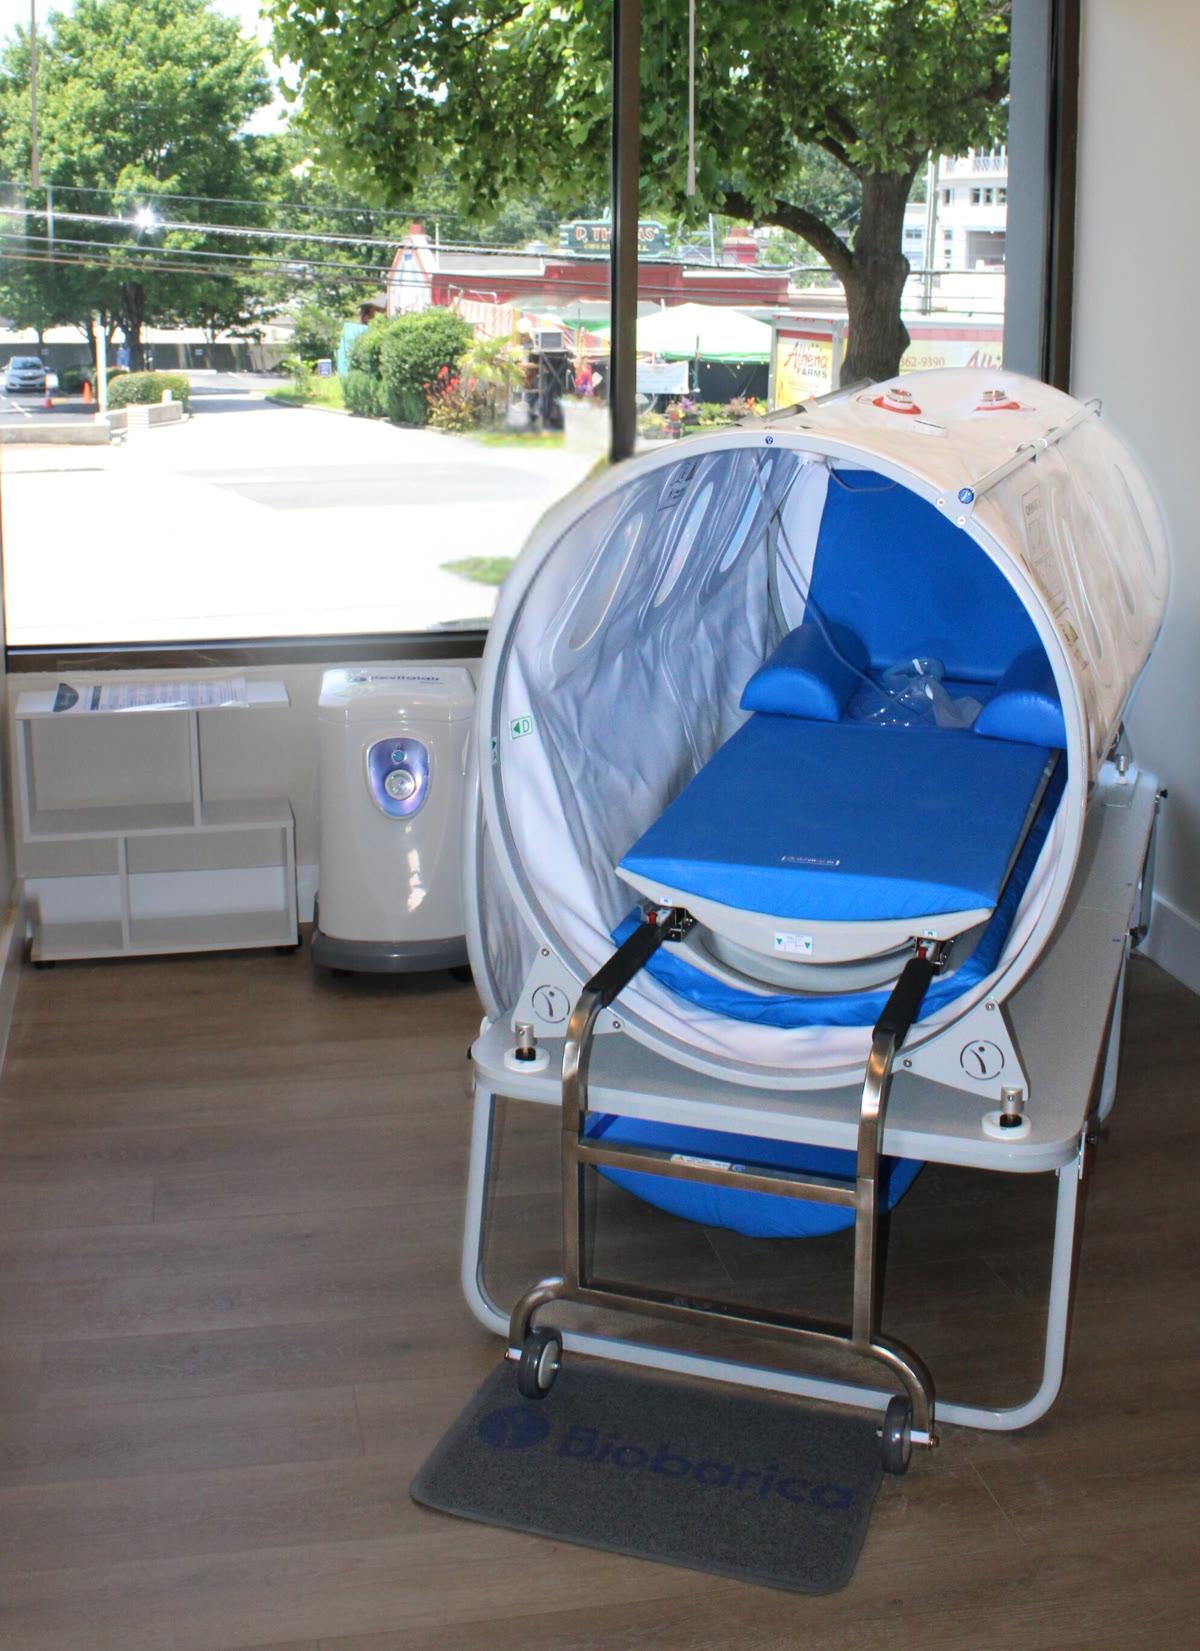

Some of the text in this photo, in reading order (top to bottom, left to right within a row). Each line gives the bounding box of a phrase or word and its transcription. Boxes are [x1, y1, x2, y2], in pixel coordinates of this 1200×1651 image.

[796, 367, 828, 379] FARMS
[522, 719, 530, 733] D
[559, 1423, 854, 1510] Biobarica
